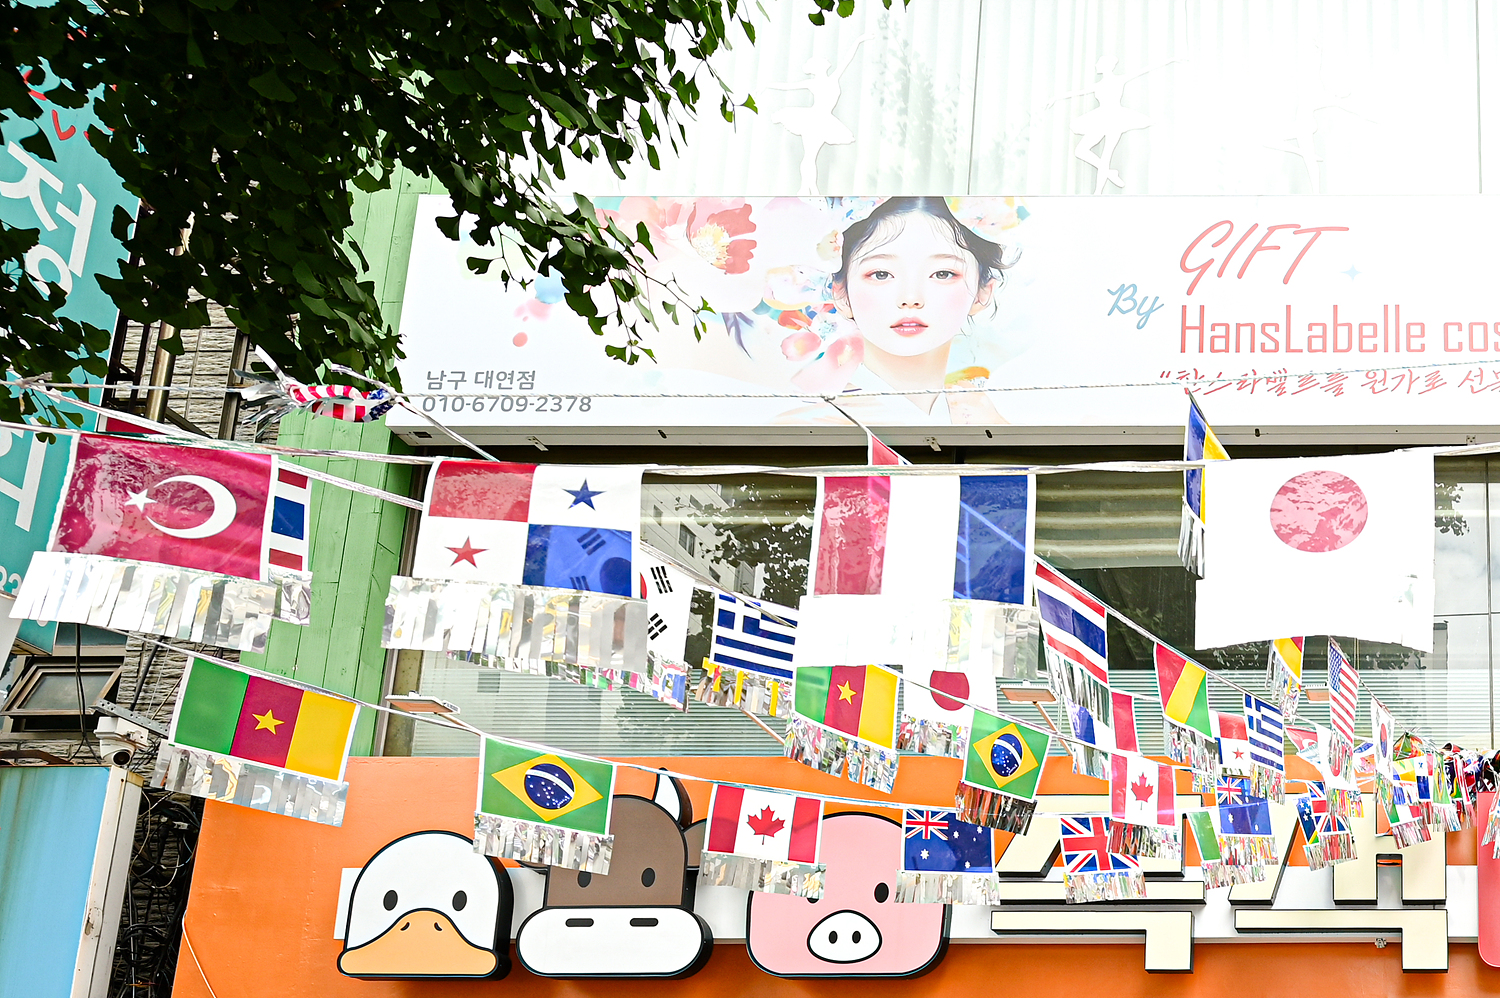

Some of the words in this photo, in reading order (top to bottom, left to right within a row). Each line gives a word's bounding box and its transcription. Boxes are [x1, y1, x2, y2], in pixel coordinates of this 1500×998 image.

[1179, 220, 1350, 296] GIFT
[1107, 283, 1164, 329] By
[1180, 304, 1426, 354] HansLabelle
[426, 370, 467, 390] 남구
[474, 370, 536, 390] 대연점
[1361, 368, 1448, 396] 원가로
[422, 395, 592, 412] 010-6709-2378
